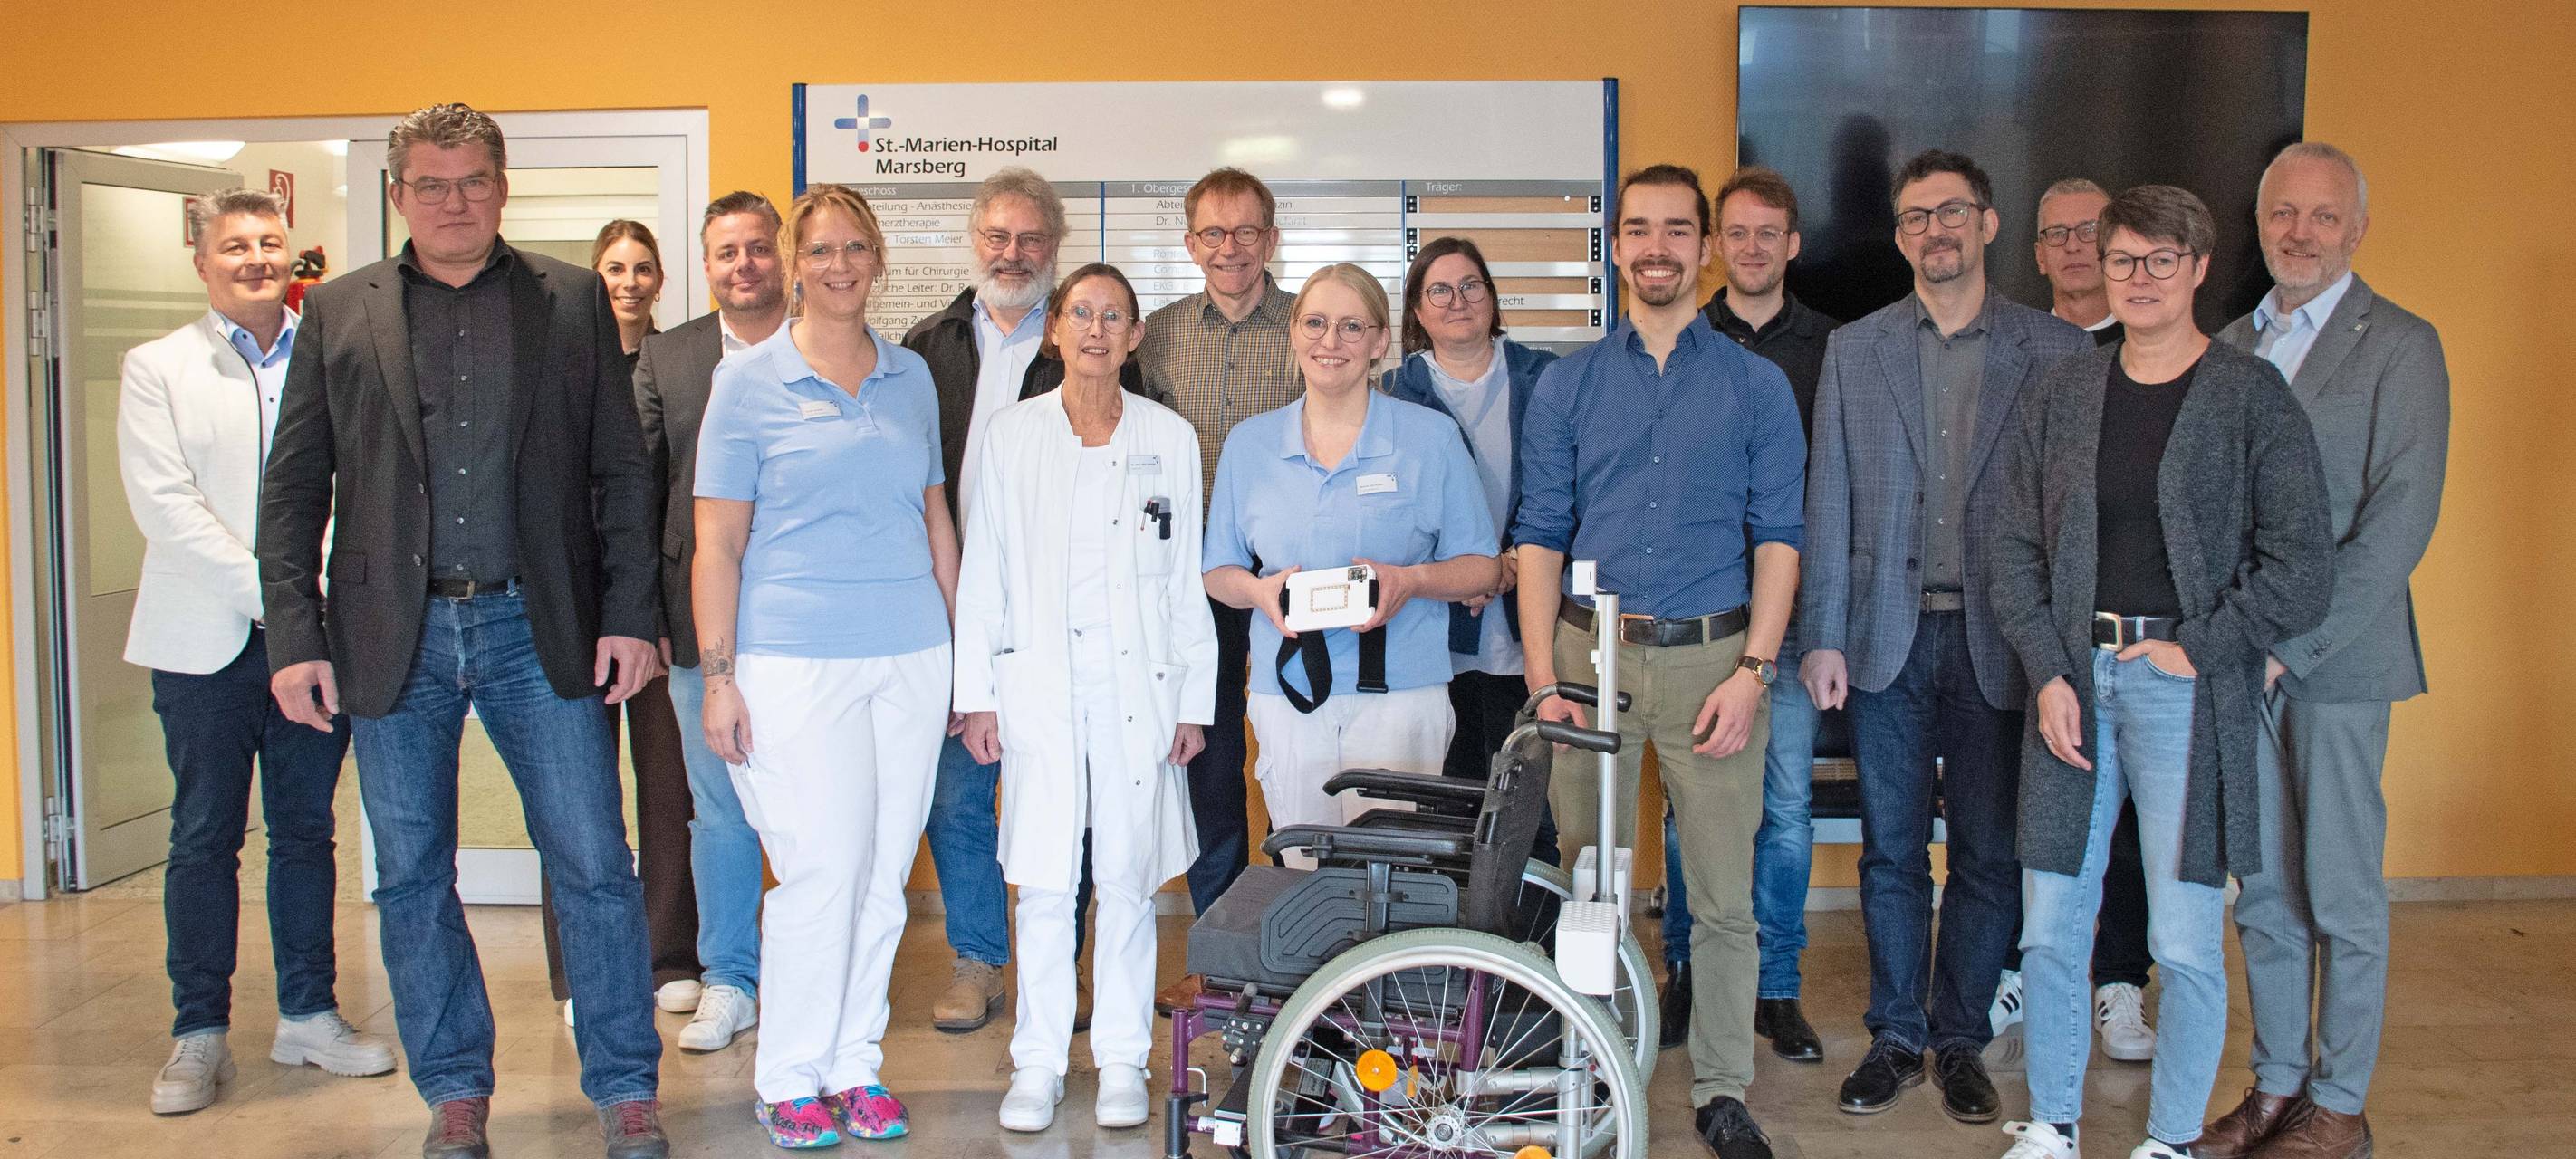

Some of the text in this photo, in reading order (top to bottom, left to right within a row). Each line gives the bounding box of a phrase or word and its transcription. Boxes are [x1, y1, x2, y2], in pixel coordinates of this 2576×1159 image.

[875, 136, 1058, 157] St.-Marien-Hospital
[875, 158, 966, 178] Marsberg
[1143, 183, 1192, 195] Obergesc
[1426, 182, 1462, 195] Träger:
[870, 202, 908, 214] teilung
[1156, 199, 1184, 209] Abtei
[894, 235, 932, 244] Torsten
[934, 235, 963, 244] Meier
[905, 267, 919, 276] für
[922, 266, 970, 278] Chirurgie
[941, 283, 956, 292] Dr.
[917, 298, 939, 309] und
[1497, 297, 1525, 306] recht
